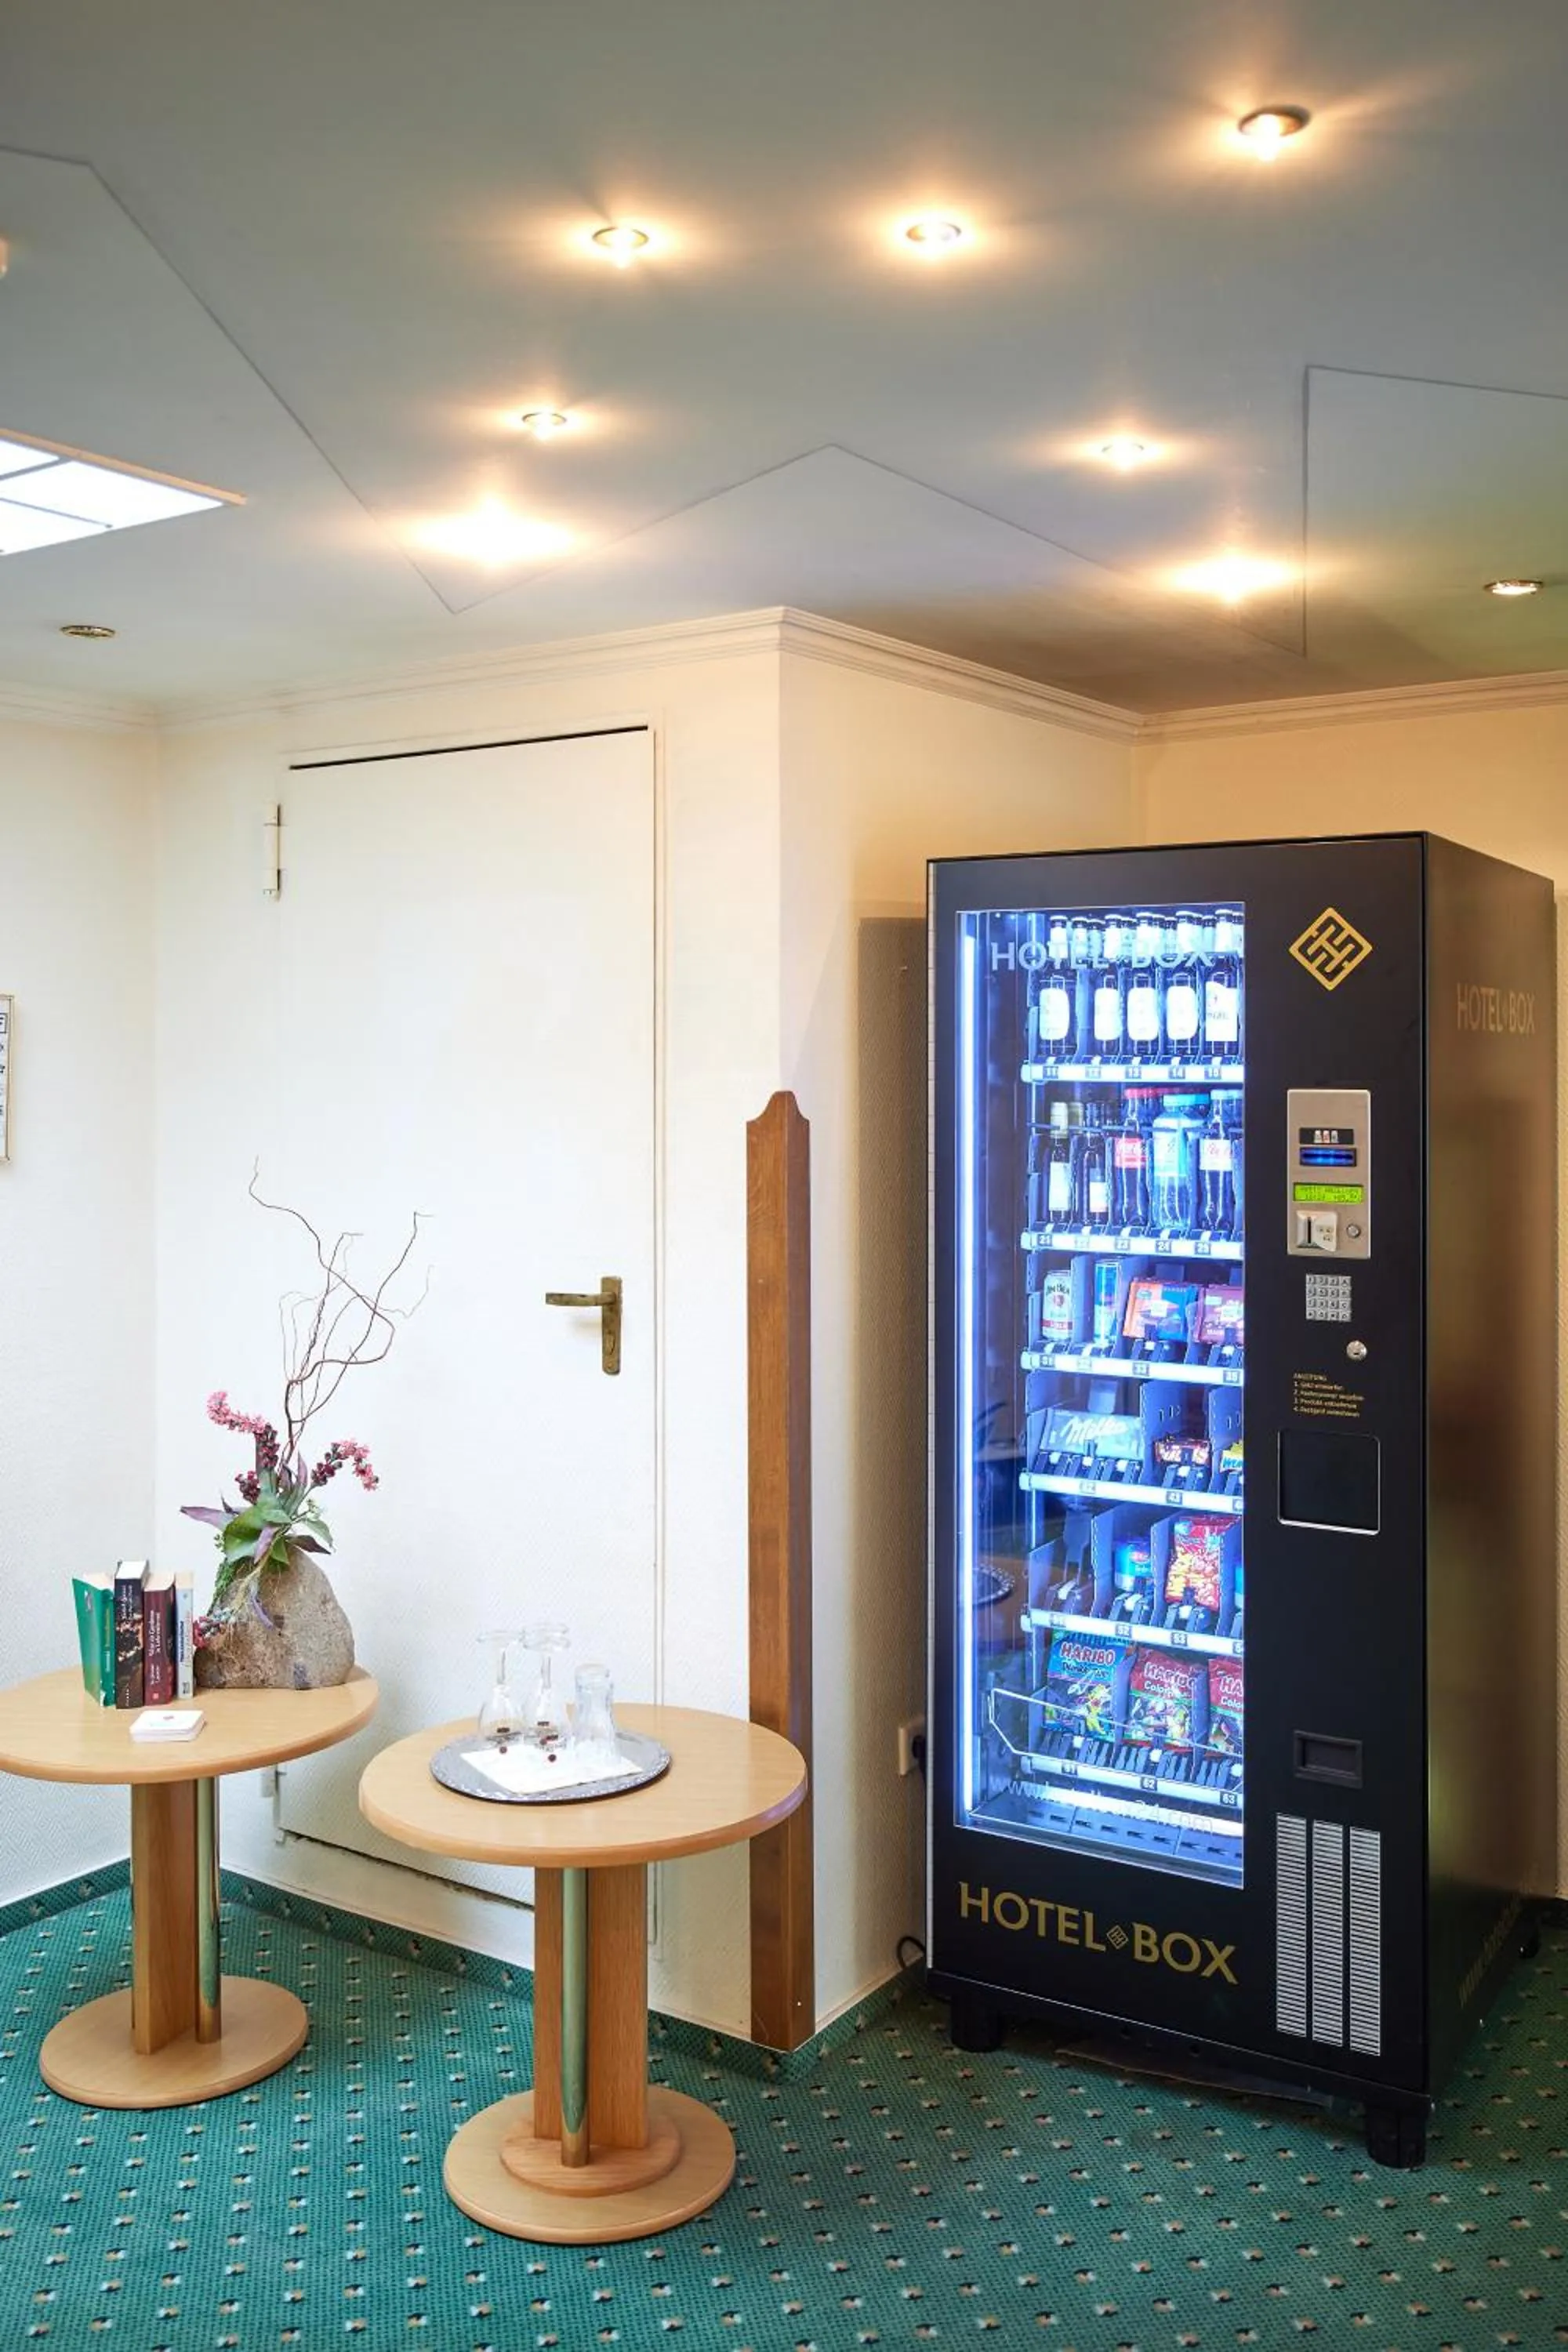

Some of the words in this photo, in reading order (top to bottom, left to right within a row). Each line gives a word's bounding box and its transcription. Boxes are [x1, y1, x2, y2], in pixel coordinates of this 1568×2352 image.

[1457, 982, 1504, 1033] HOTEL
[1509, 989, 1535, 1036] BOX
[1059, 1641, 1116, 1666] HARIBO
[959, 1882, 1106, 1952] HOTEL
[1131, 1922, 1239, 1985] BOX
